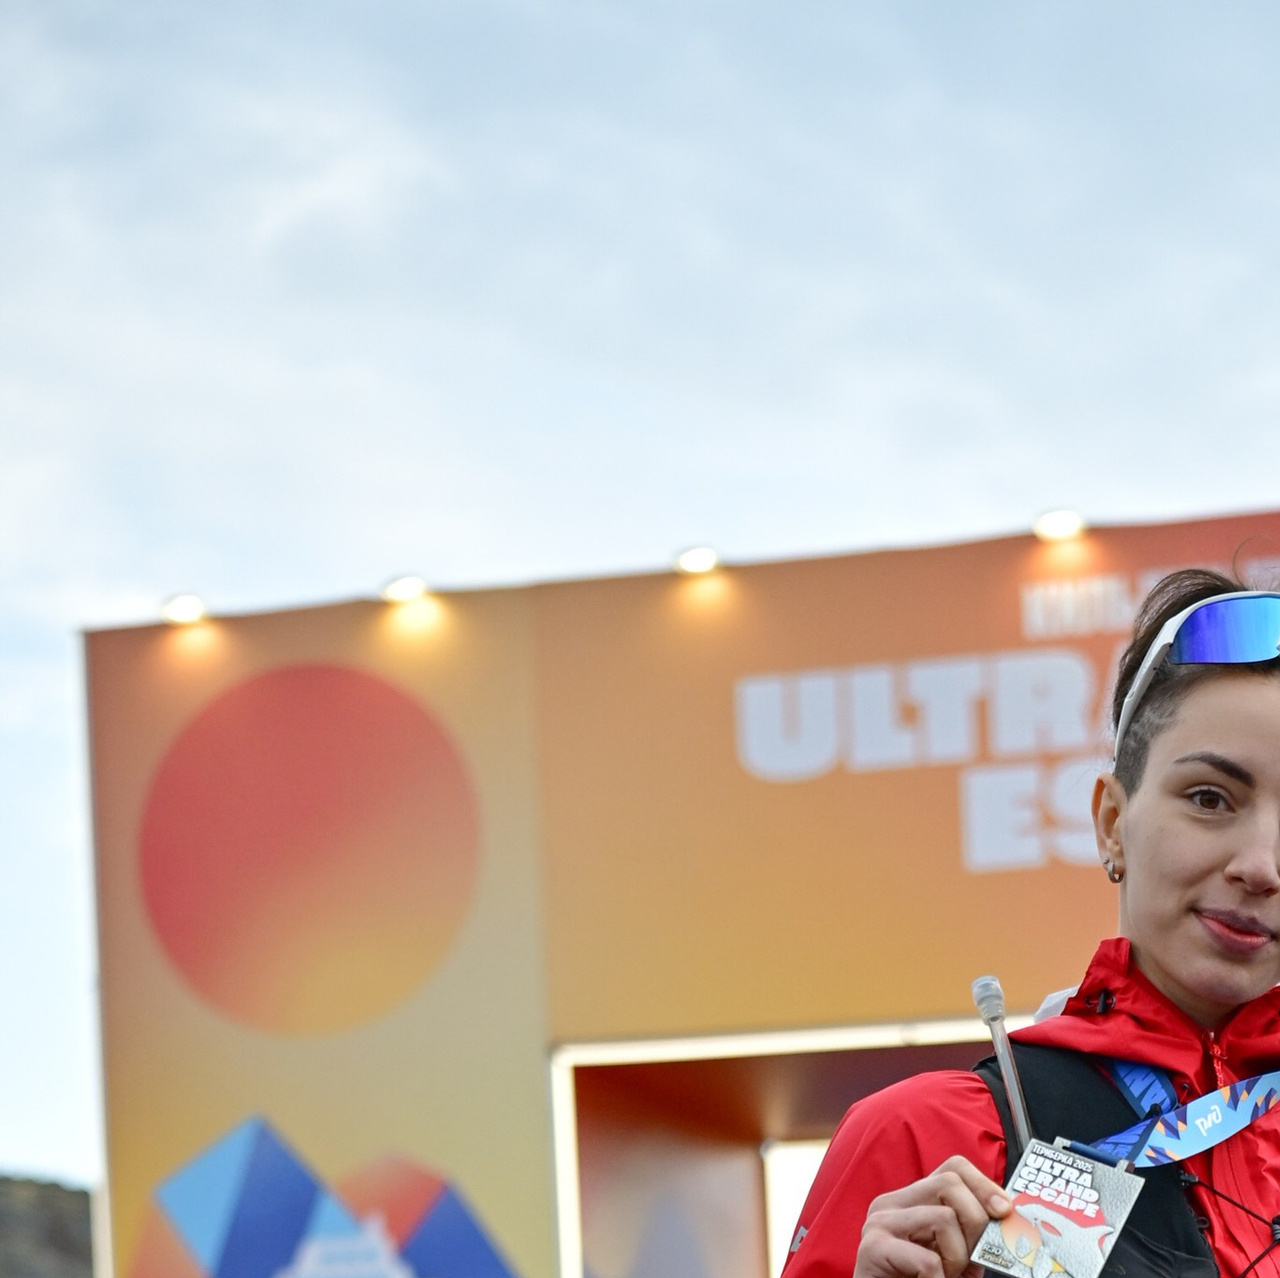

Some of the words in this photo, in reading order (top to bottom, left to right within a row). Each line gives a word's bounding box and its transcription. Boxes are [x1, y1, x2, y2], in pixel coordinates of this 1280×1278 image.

[735, 647, 1120, 783] ULTR
[1025, 1153, 1094, 1189] ULTRA
[1032, 1144, 1073, 1167] ТЕРИБЕРКА
[1073, 1159, 1094, 1174] 2025
[1012, 1177, 1101, 1219] ESCAPE
[1019, 1166, 1100, 1204] GRAND
